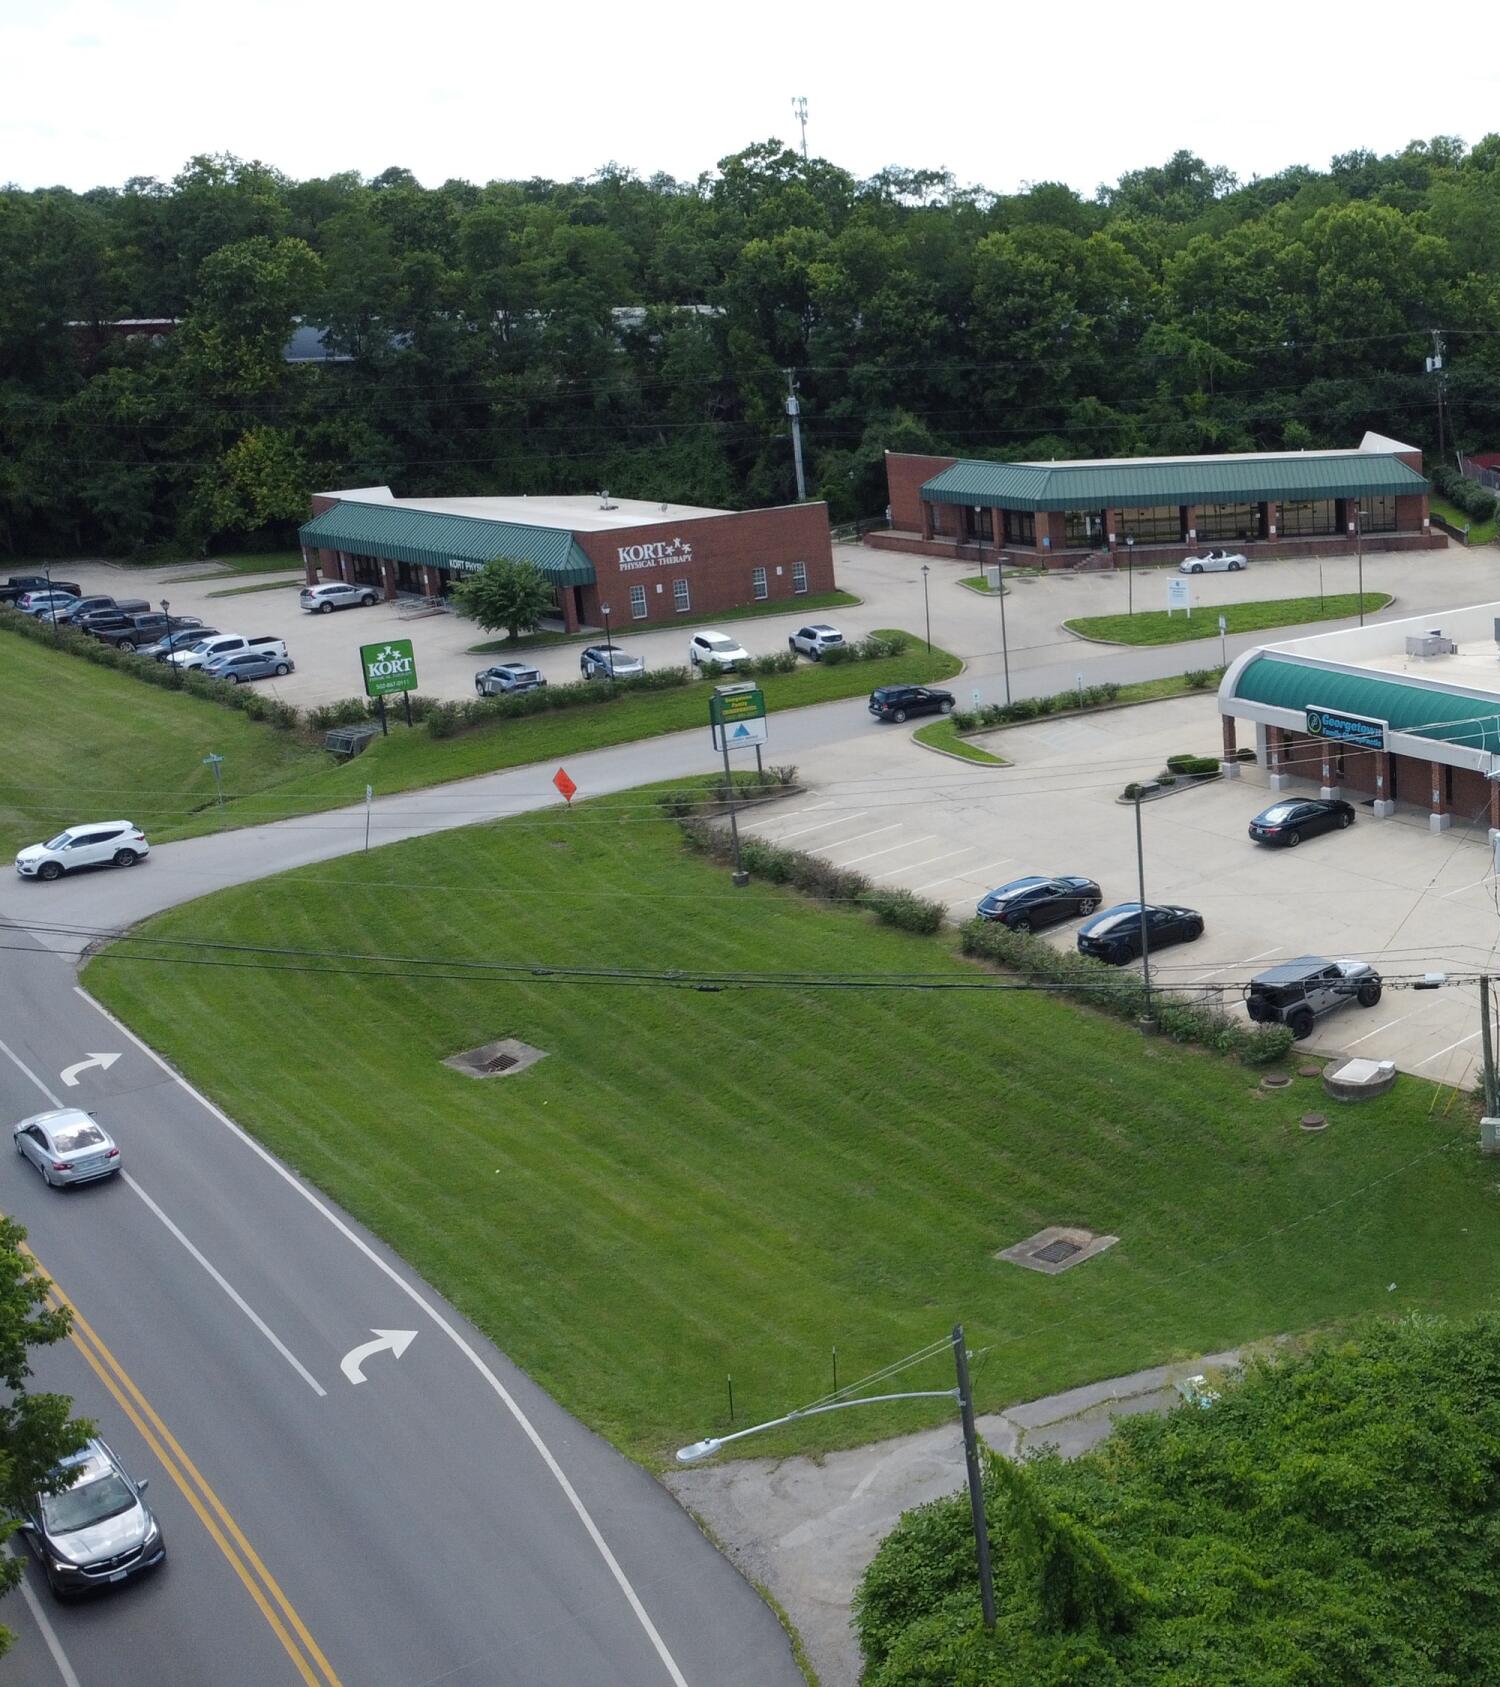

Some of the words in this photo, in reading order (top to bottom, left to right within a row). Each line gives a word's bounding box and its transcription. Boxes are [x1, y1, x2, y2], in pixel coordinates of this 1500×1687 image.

[617, 542, 666, 563] KORT
[449, 559, 465, 570] KORT
[619, 559, 657, 572] PHYSICAL
[659, 554, 692, 566] THERAPY
[368, 657, 413, 677] KORT
[1322, 714, 1383, 737] Georgetown
